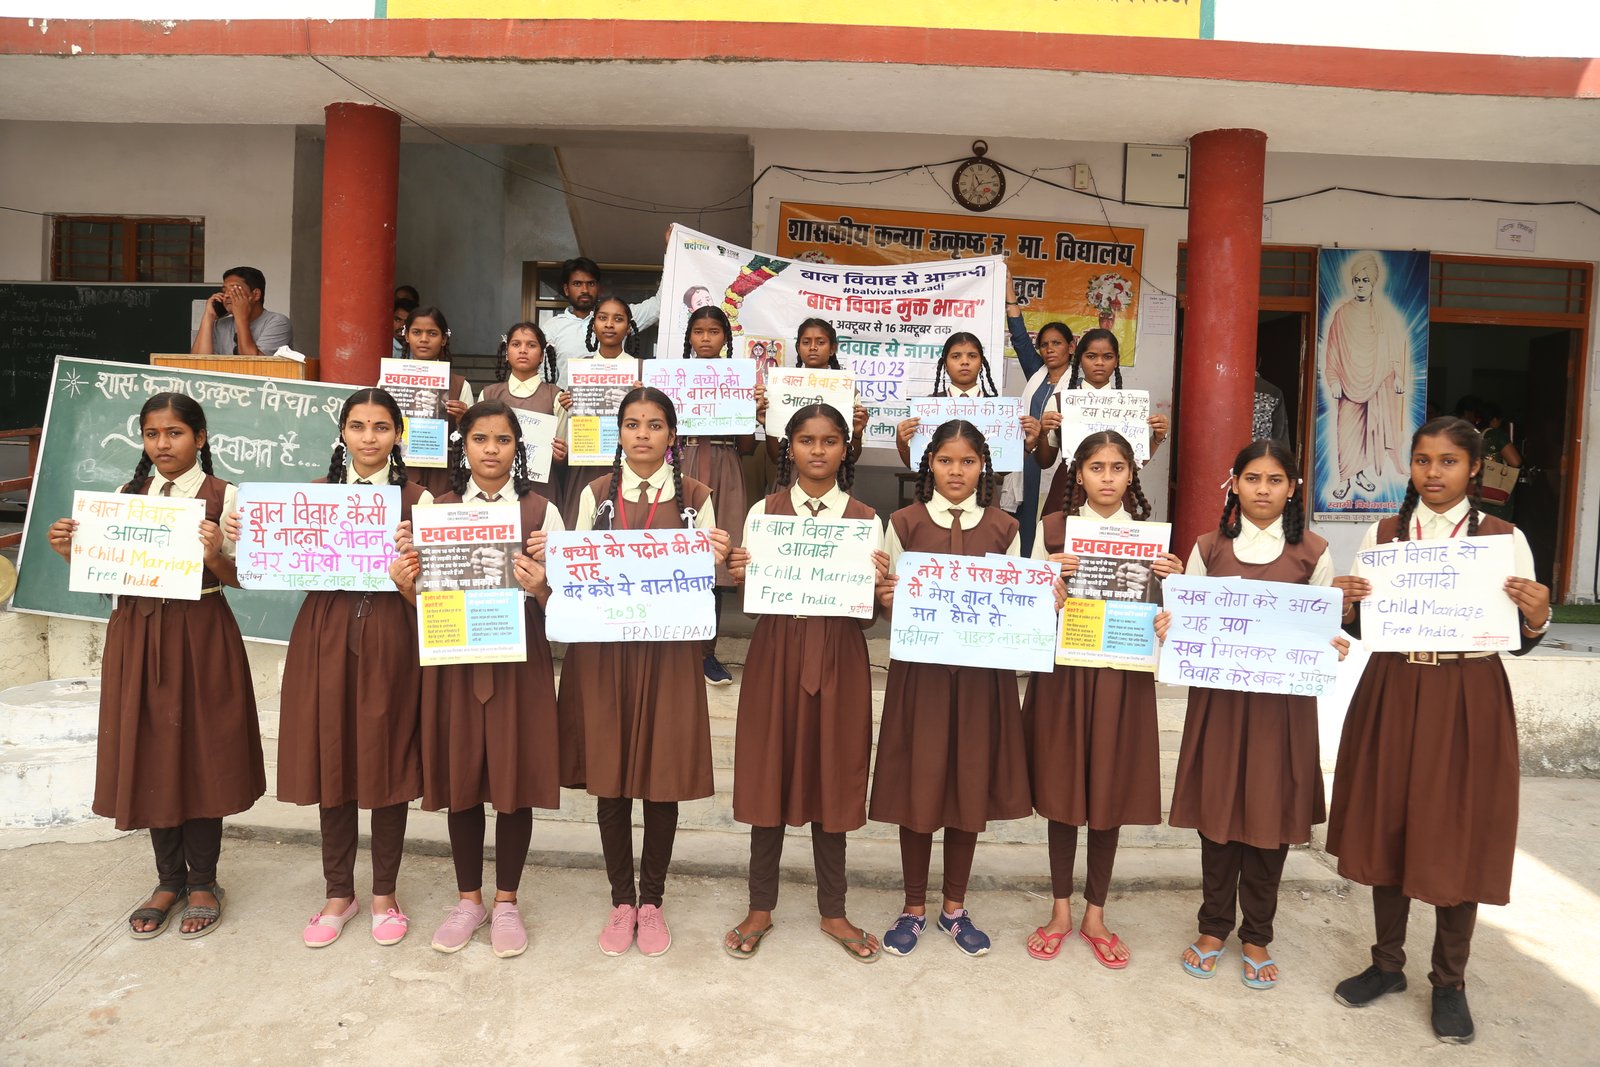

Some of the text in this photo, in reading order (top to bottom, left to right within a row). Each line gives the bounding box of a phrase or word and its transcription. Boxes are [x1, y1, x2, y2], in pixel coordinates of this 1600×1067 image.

[787, 216, 871, 246] शासकीय
[874, 225, 925, 250] कन्या
[990, 233, 1010, 257] उ.
[1017, 235, 1049, 260] मा.
[1055, 232, 1135, 266] विद्यालय
[800, 270, 918, 286] बाल विवाह से
[842, 283, 944, 295] #balvivahseazadi
[845, 295, 892, 315] विवाह
[896, 298, 932, 322] मुक्त
[836, 320, 871, 334] अक्टूबर
[873, 320, 882, 333] से
[886, 324, 896, 333] 16
[898, 324, 931, 337] अक्टूबर
[934, 324, 953, 334] तक
[837, 336, 900, 357] विवाह से
[384, 373, 446, 387] खबरदार!
[571, 373, 635, 385] खबरदार!
[675, 368, 686, 387] दी
[724, 367, 740, 387] को
[782, 373, 855, 391] बाल विवाह से
[687, 383, 755, 400] बाल विवाह
[1065, 394, 1088, 406] बाल
[946, 399, 980, 416] खेलने
[980, 401, 995, 415] की
[1081, 407, 1100, 417] हम
[1102, 408, 1121, 419] सब
[870, 422, 896, 437] (जीन)
[210, 433, 278, 474] स्वागत
[89, 500, 125, 518] बाल
[127, 498, 185, 528] विवाह
[247, 491, 387, 525] बाल विवाह कैसी
[104, 525, 172, 548] आजादी
[249, 520, 268, 548] ये
[333, 520, 387, 549] जीवन
[420, 524, 515, 543] खबरदार!
[751, 518, 872, 540] # बाल विवाह से
[603, 533, 626, 558] को
[671, 533, 690, 555] की
[777, 541, 838, 558] आजादी
[1072, 538, 1163, 558] खबरदार!
[1362, 540, 1489, 567] बाल विवाह से
[88, 545, 125, 564] Child
[130, 549, 202, 576] Marriage
[249, 551, 283, 573] भर
[346, 543, 398, 573] पानी
[88, 566, 118, 581] Free
[323, 574, 356, 587] लाइन
[749, 563, 872, 586] # Child Marriage
[949, 560, 962, 582] है
[966, 563, 993, 583] पंख
[995, 562, 1022, 585] मुझे
[1391, 565, 1460, 589] आजादी
[563, 569, 715, 600] बंद करो ये बाल विवाह
[761, 586, 793, 604] Free
[929, 581, 955, 603] मेरा
[961, 589, 993, 606] बाल
[999, 587, 1037, 607] विवाह
[1214, 586, 1250, 608] लोग
[1253, 589, 1278, 610] करे
[1288, 598, 1331, 615] आज
[1377, 599, 1418, 614] Child
[1421, 599, 1485, 621] Marriage
[910, 604, 1006, 627] मत होने दो
[1181, 615, 1211, 634] यह
[622, 625, 713, 640] PRADEEPAN
[1382, 622, 1412, 637] Free
[1172, 637, 1324, 665] सब मिलकर बाल
[1179, 660, 1224, 681] विवाह
[1226, 661, 1251, 686] करे
